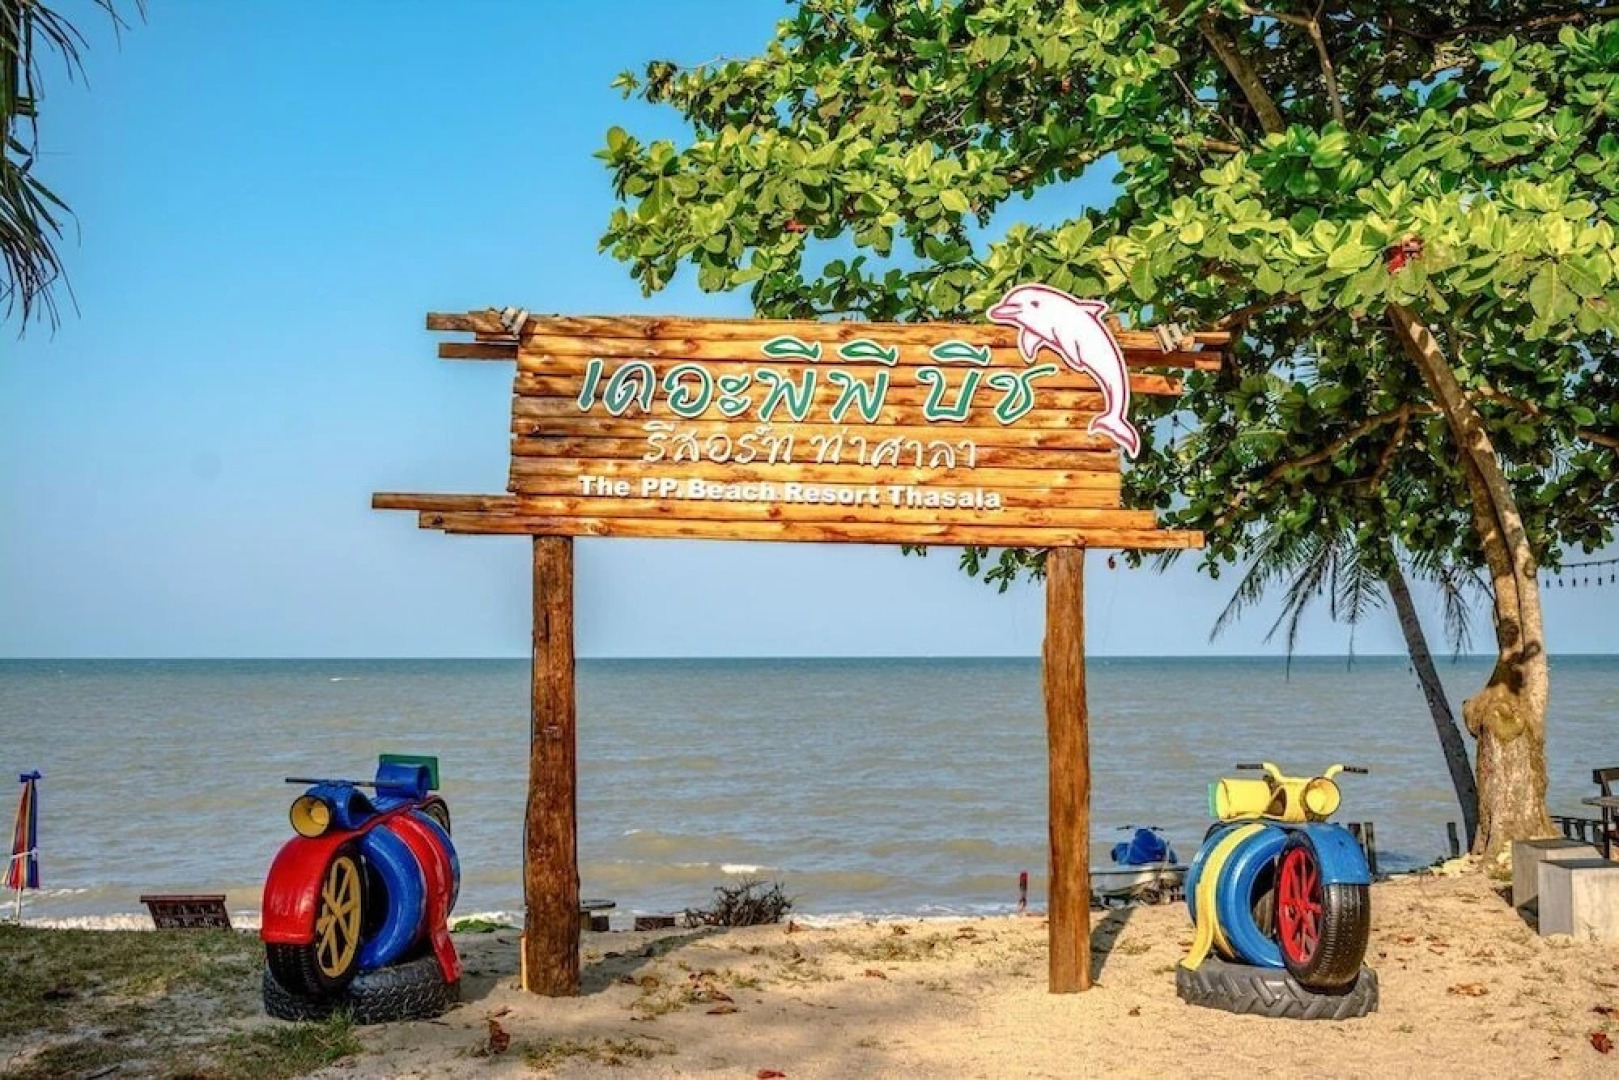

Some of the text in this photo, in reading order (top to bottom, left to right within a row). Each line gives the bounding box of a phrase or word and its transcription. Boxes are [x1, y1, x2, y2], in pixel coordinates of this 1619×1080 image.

[642, 420, 976, 468] รีสอร์ท ท่าศาลา
[578, 474, 631, 497] The
[688, 478, 775, 502] Beach
[784, 481, 880, 507] Resort
[888, 484, 1002, 510] Thasala
